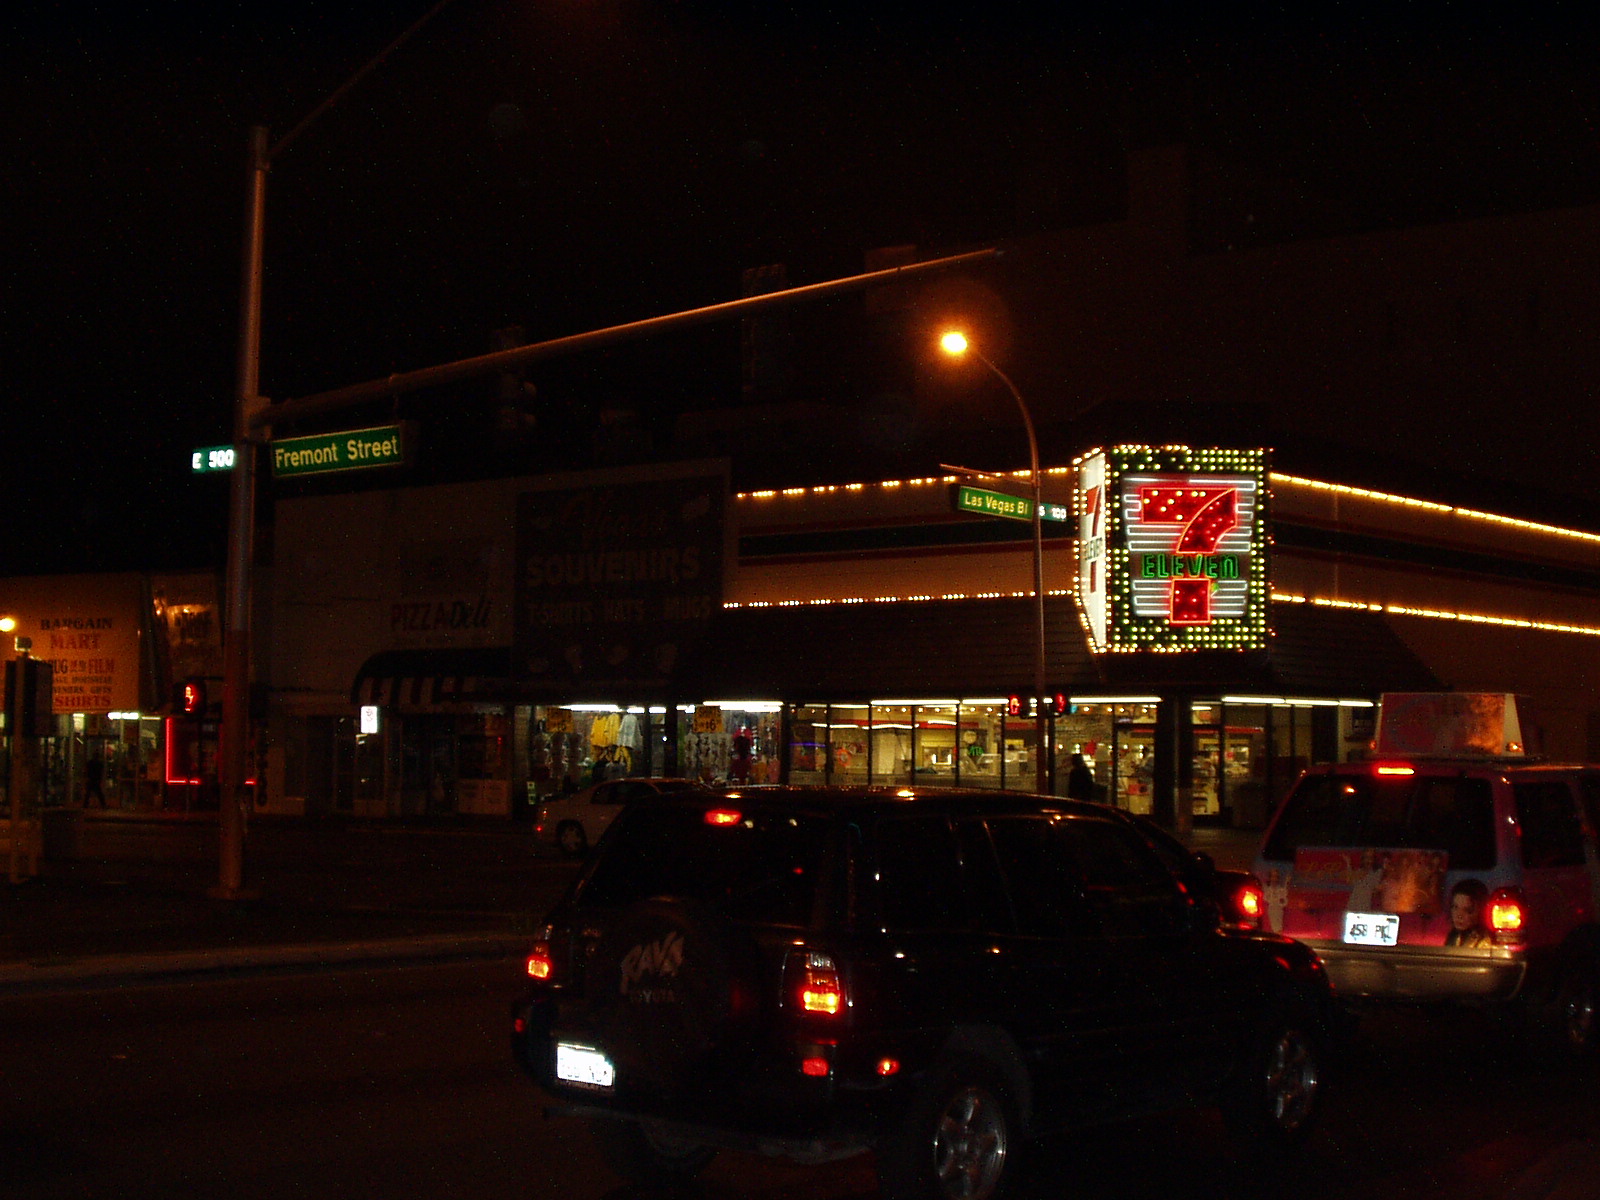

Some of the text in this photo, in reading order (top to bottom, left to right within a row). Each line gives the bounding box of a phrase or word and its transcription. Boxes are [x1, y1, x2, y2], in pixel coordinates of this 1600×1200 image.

[192, 452, 202, 469] E
[275, 435, 398, 468] Fremont Street
[964, 492, 982, 507] Las
[985, 495, 1015, 514] Vegas
[526, 546, 701, 587] SOUVENIRS
[40, 618, 112, 630] BARGAIN
[391, 602, 446, 631] PIZZA
[50, 633, 101, 649] MART
